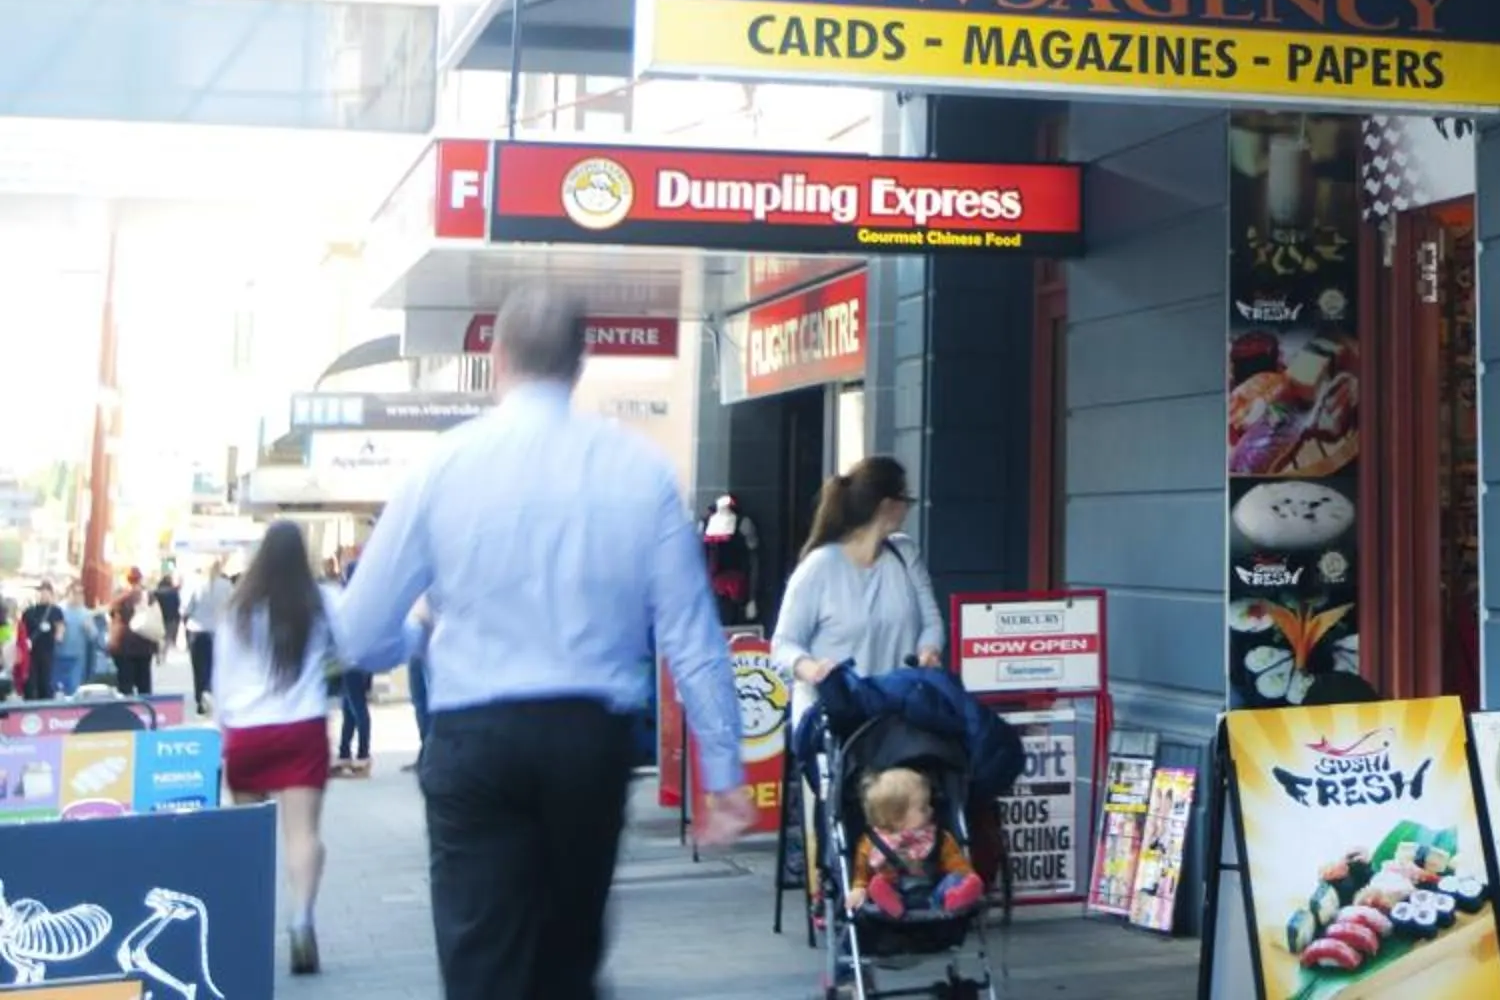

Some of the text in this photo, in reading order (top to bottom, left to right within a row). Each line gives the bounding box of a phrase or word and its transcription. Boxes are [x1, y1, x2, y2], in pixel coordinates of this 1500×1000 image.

[747, 14, 906, 61] CARDS
[962, 25, 1238, 79] MAGAZINES
[1287, 43, 1445, 89] PAPERS
[656, 170, 859, 222] Dumpling
[870, 177, 1022, 223] Express
[858, 229, 1021, 247] Gourmet Chinese Food
[584, 327, 660, 345] ENTRE
[751, 298, 860, 377] FLIGHT CENTRE
[972, 639, 1087, 654] NOW OPEN
[1022, 741, 1067, 778] ort
[1314, 752, 1391, 776] SUSHI
[1272, 757, 1433, 808] FRESH
